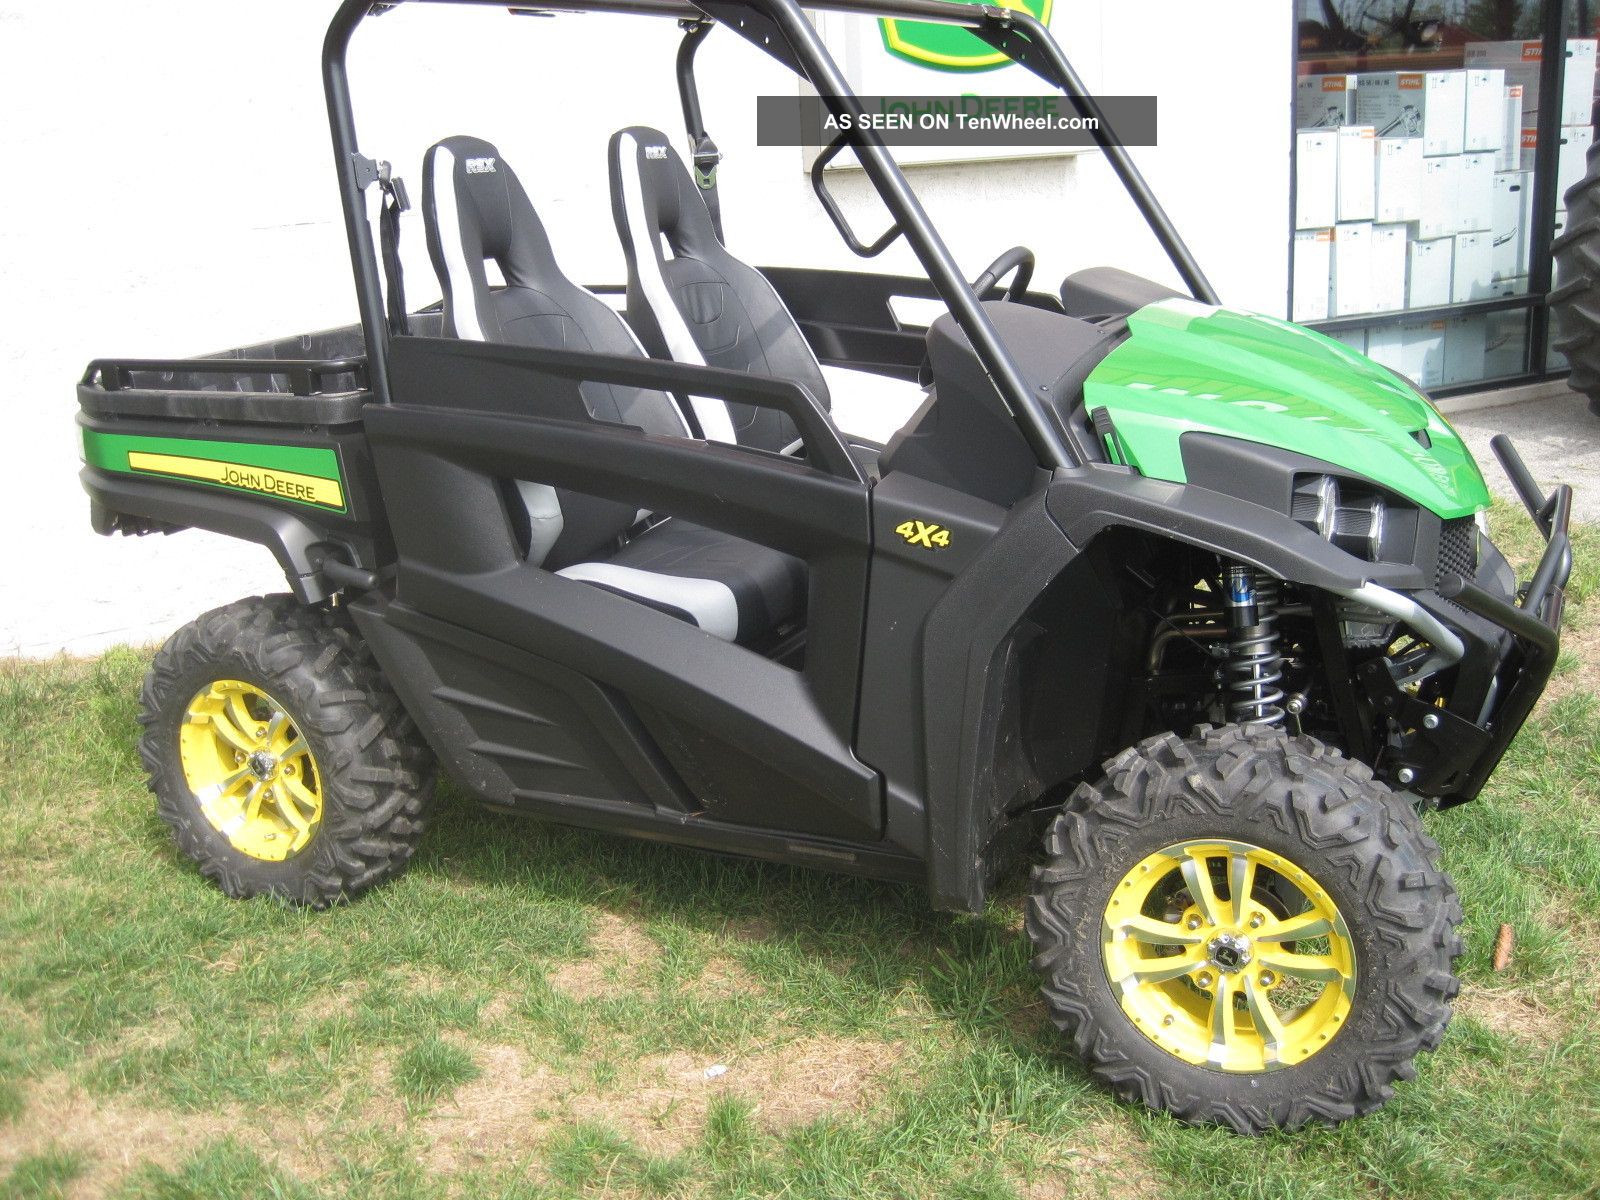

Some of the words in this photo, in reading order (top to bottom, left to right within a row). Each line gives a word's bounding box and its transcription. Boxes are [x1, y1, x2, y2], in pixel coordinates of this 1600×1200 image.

[1524, 47, 1543, 57] STI
[961, 93, 1060, 123] DEERE
[221, 466, 261, 488] JOHN
[263, 473, 316, 500] DEERE
